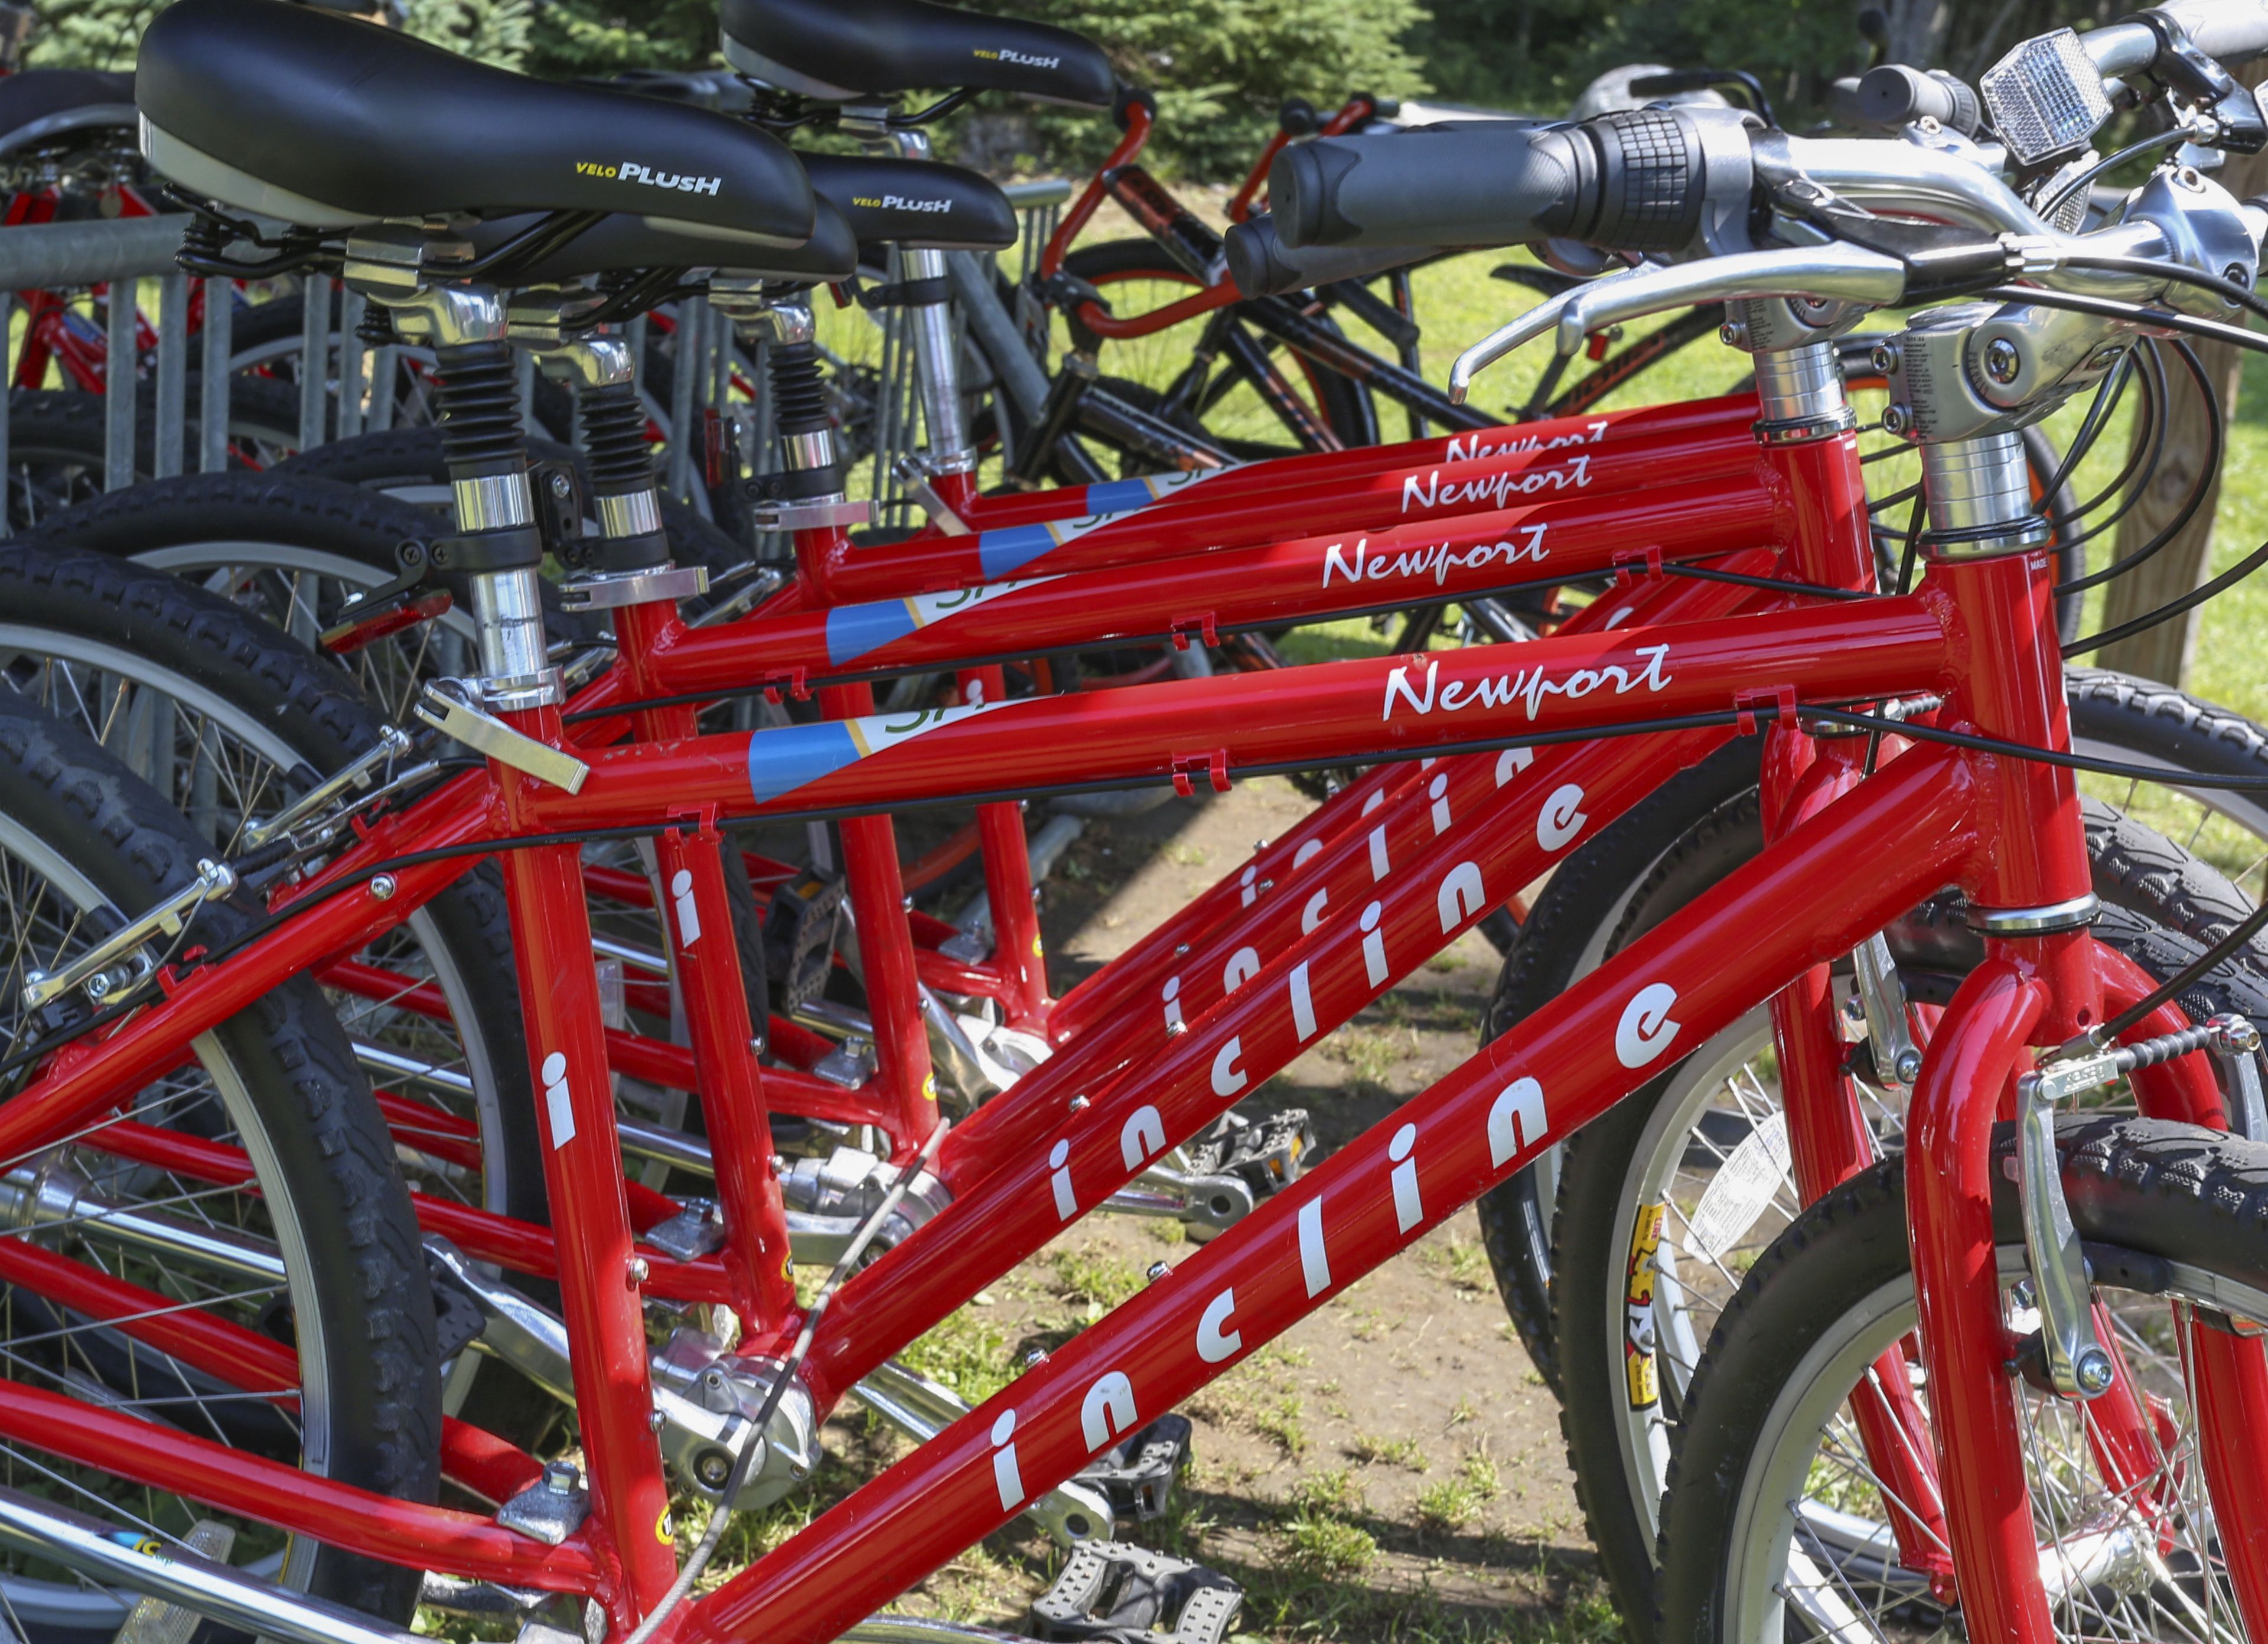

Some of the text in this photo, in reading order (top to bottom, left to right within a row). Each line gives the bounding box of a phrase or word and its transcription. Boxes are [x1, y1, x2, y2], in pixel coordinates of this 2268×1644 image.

[973, 49, 1060, 69] VELO PLUSH
[575, 161, 722, 197] VELO PLUSH
[852, 195, 952, 213] VELO PLUSH
[1402, 454, 1592, 513] Newport
[1322, 523, 1550, 589] Newport
[1382, 643, 1672, 722] Newport
[1162, 746, 1534, 1027] inclin
[1048, 783, 1588, 1222] incline
[989, 982, 1681, 1513] incline
